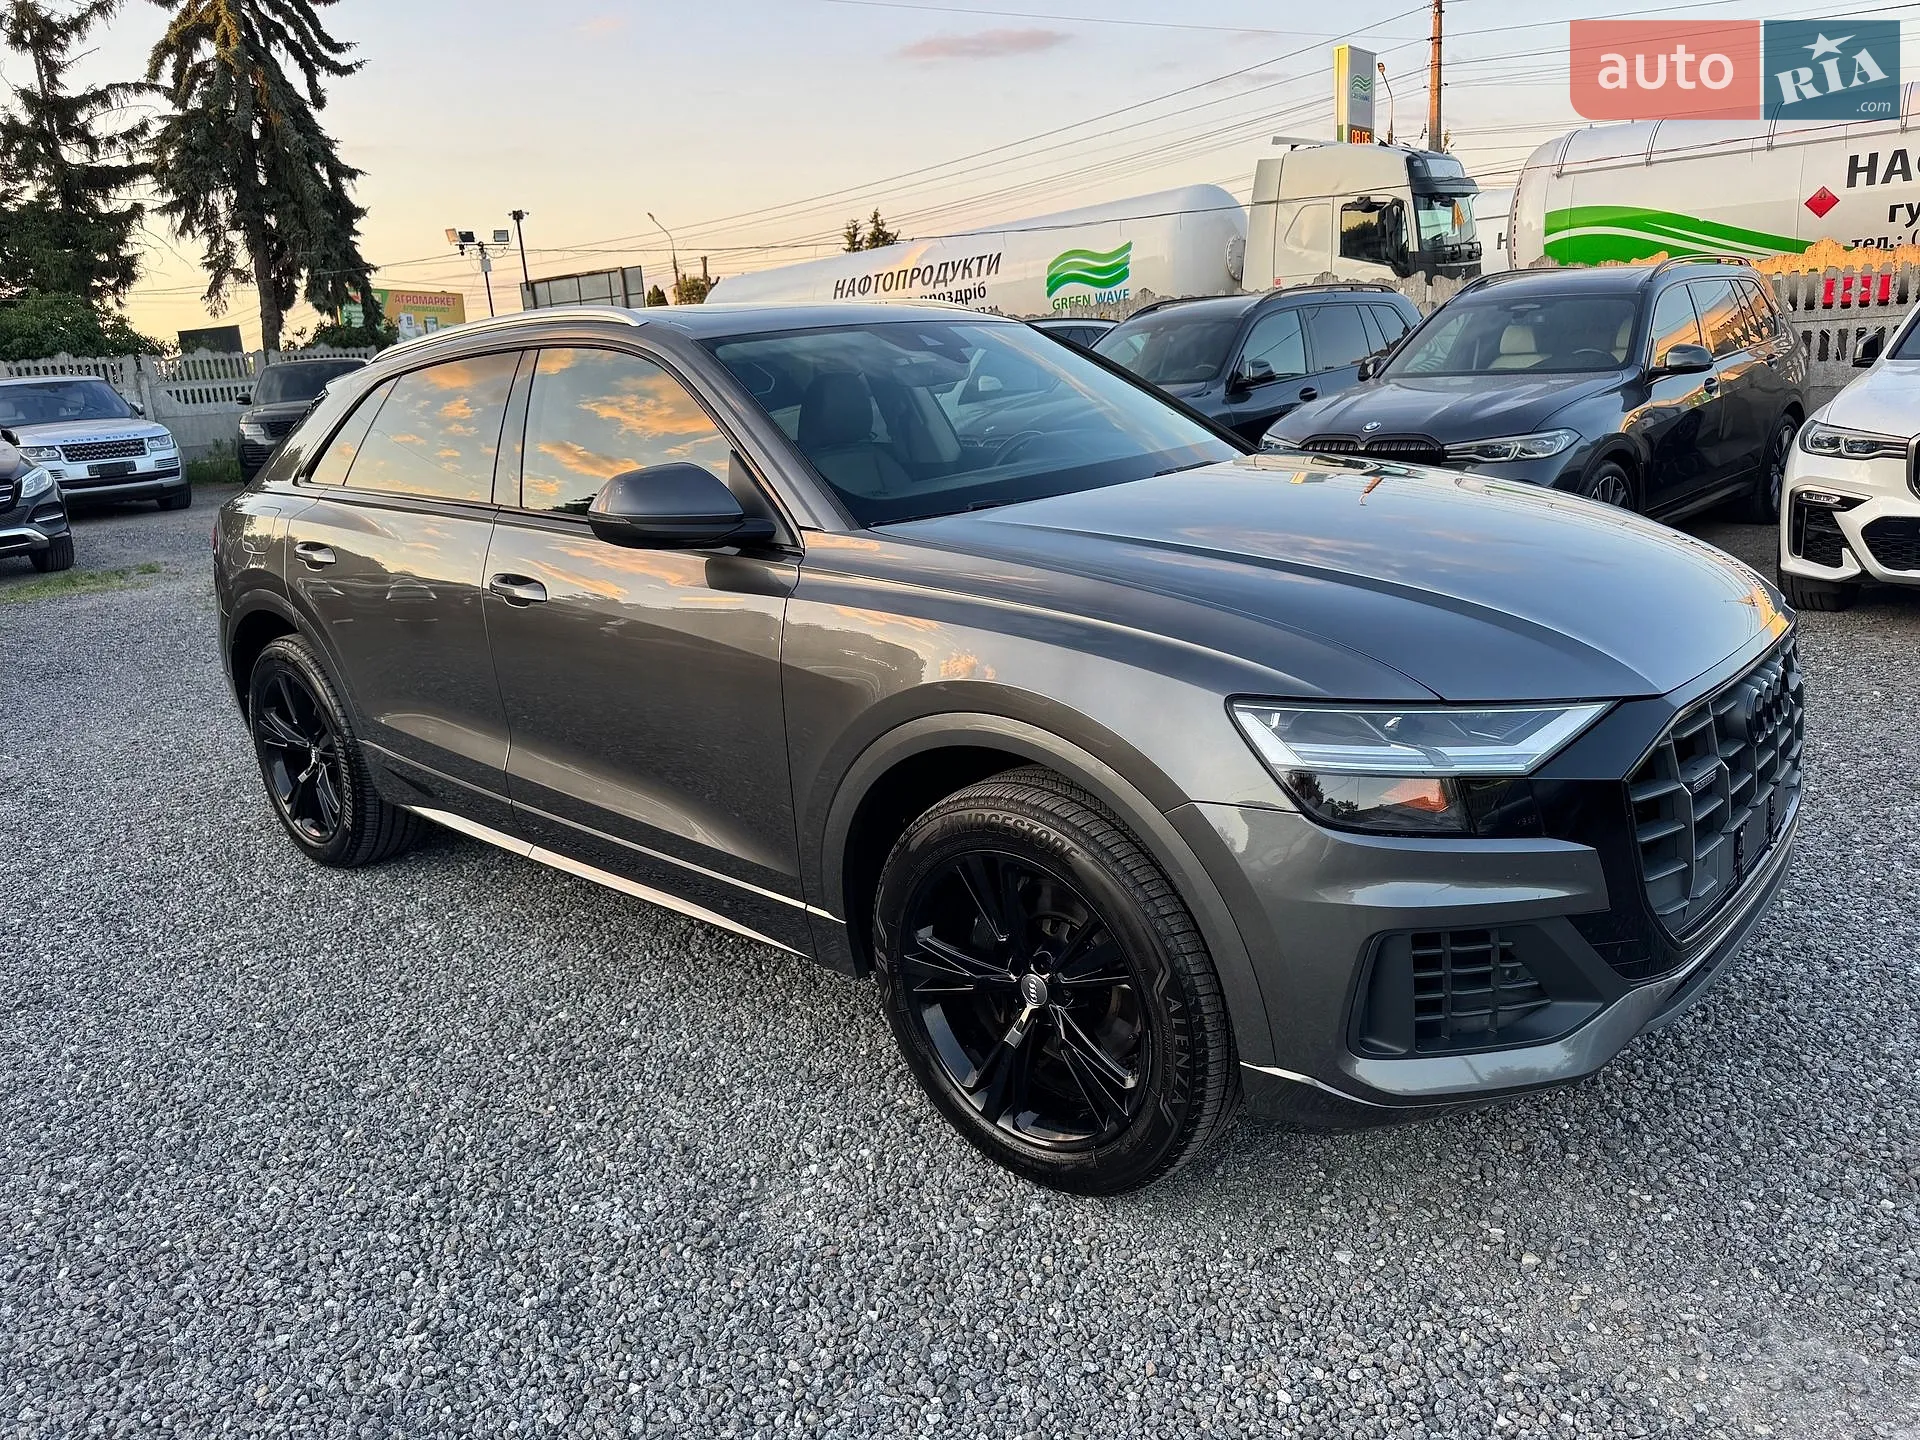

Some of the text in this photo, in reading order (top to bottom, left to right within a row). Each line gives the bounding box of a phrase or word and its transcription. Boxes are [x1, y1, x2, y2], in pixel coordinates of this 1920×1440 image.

[1846, 149, 1920, 188] НА
[833, 252, 1002, 300] НАФТОПРОДУКТИ
[1095, 288, 1130, 305] WAVE
[394, 295, 456, 306] АГРОМАРКЕТ
[938, 812, 1081, 865] BRIDGESTONE
[1166, 996, 1191, 1104] ALENZA
